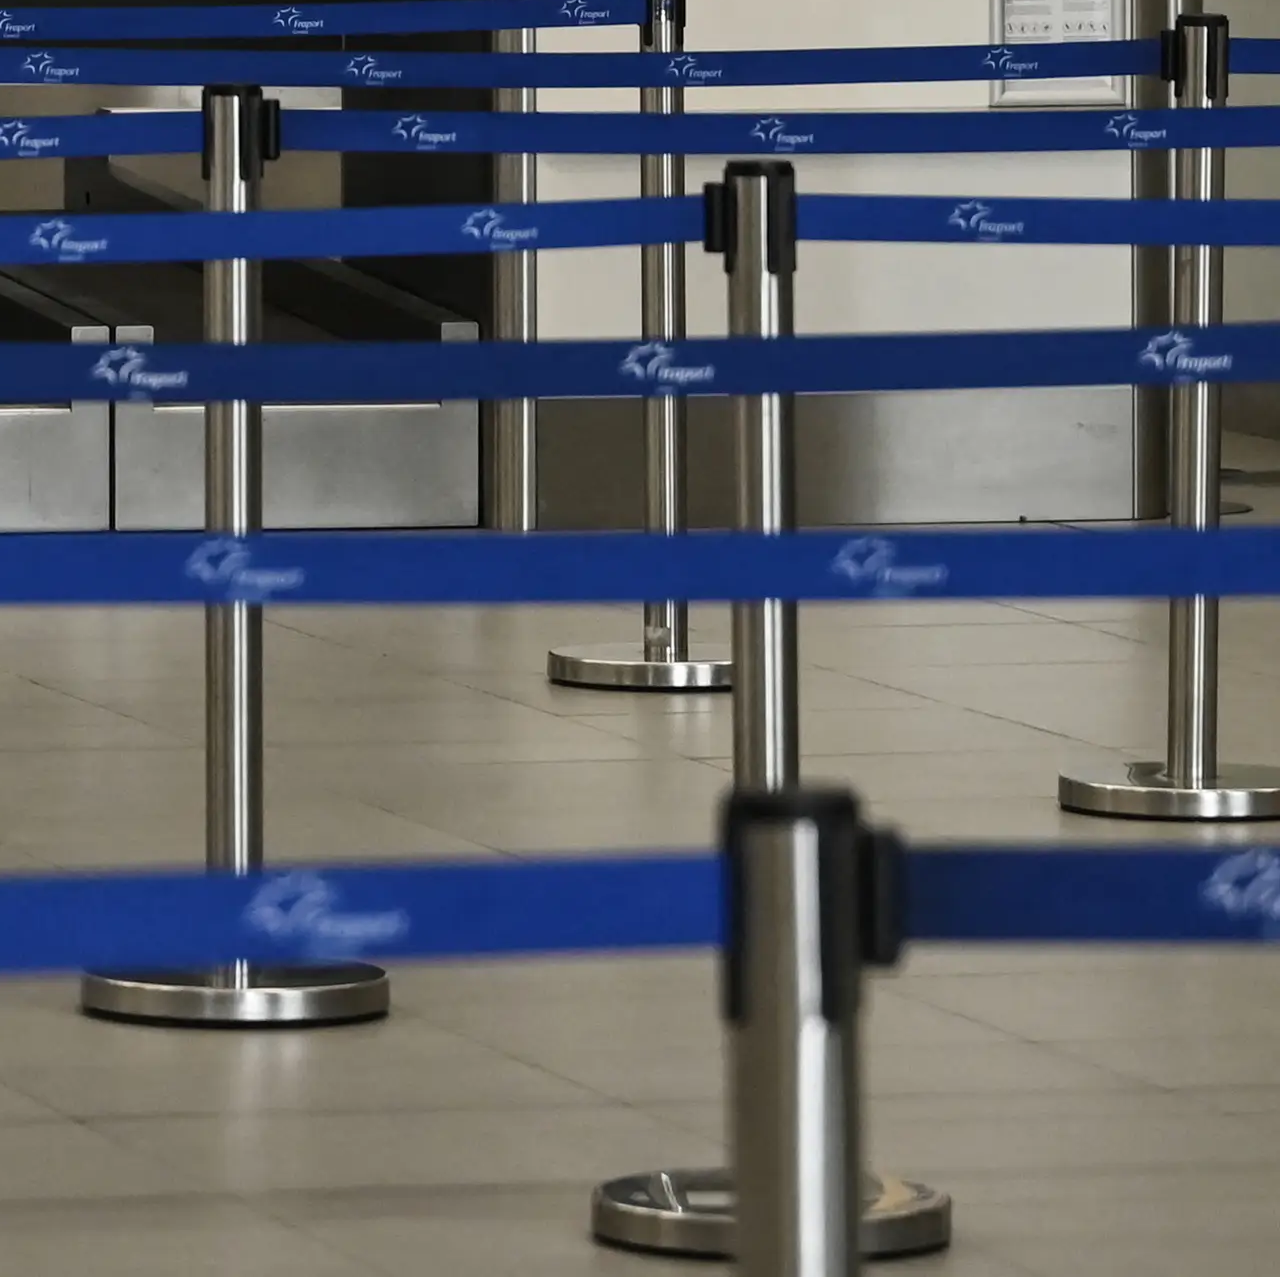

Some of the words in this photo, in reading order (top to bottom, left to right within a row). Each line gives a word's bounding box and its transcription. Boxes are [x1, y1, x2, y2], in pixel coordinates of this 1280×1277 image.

[580, 9, 610, 20] Fraport
[5, 23, 35, 33] Fraport
[294, 19, 324, 29] Fraport
[1006, 61, 1038, 72] Fraport
[46, 67, 79, 78] Fraport
[369, 69, 402, 81] Fraport
[689, 69, 722, 80] Fraport
